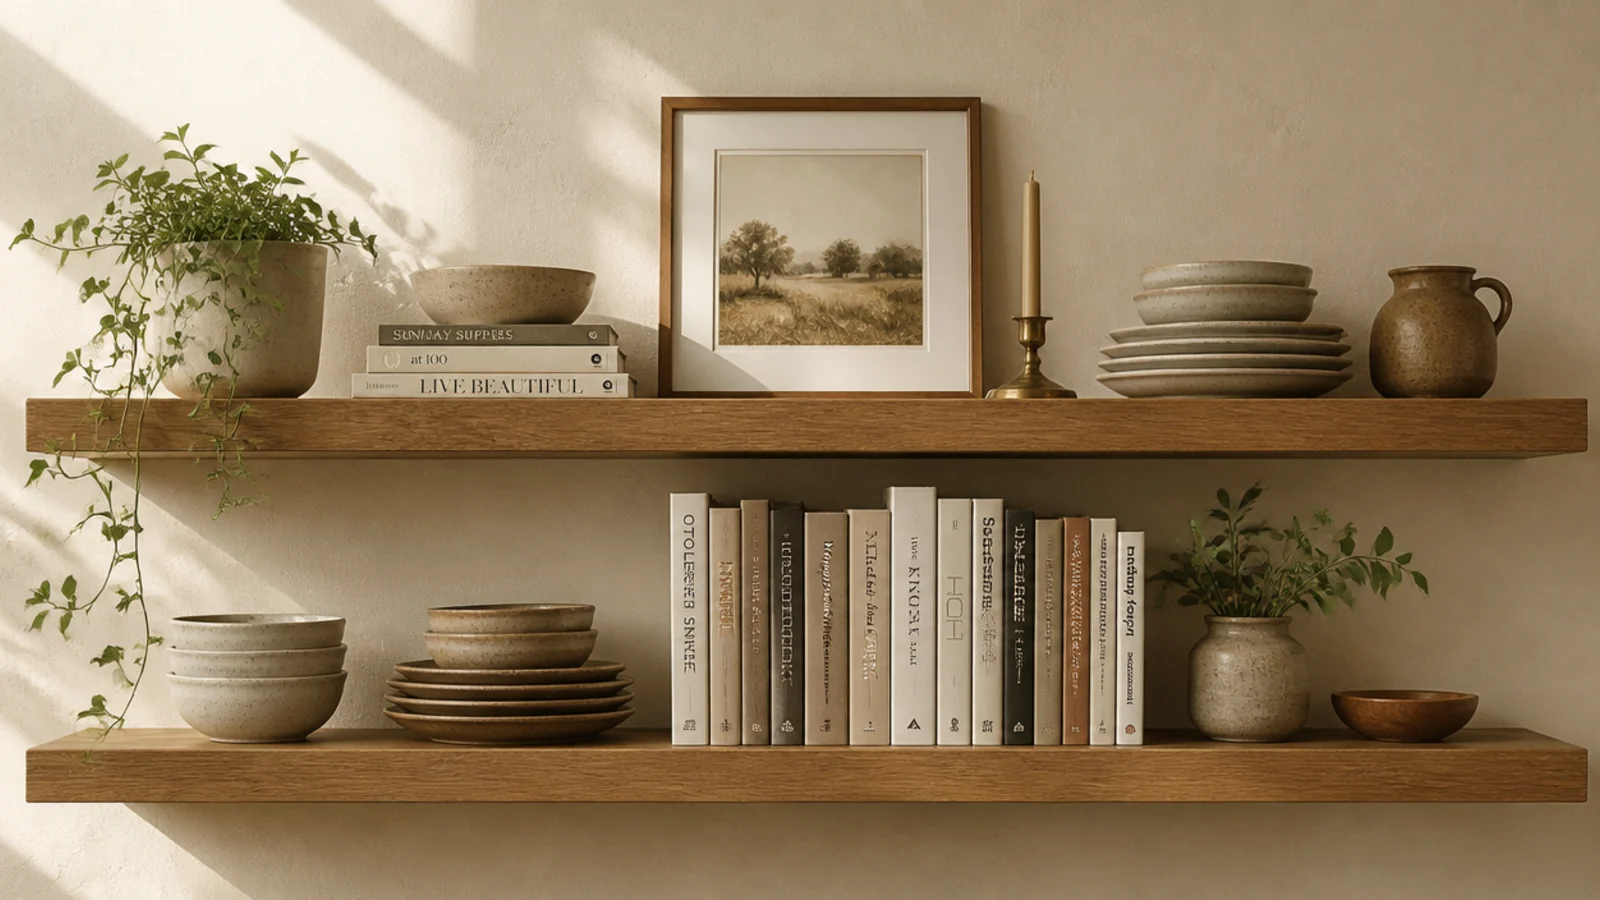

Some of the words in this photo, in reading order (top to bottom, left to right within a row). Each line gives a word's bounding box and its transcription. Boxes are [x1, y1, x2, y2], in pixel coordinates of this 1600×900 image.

[410, 355, 422, 365] at
[420, 378, 466, 394] LIVE
[471, 378, 584, 394] BEAUTIFUL
